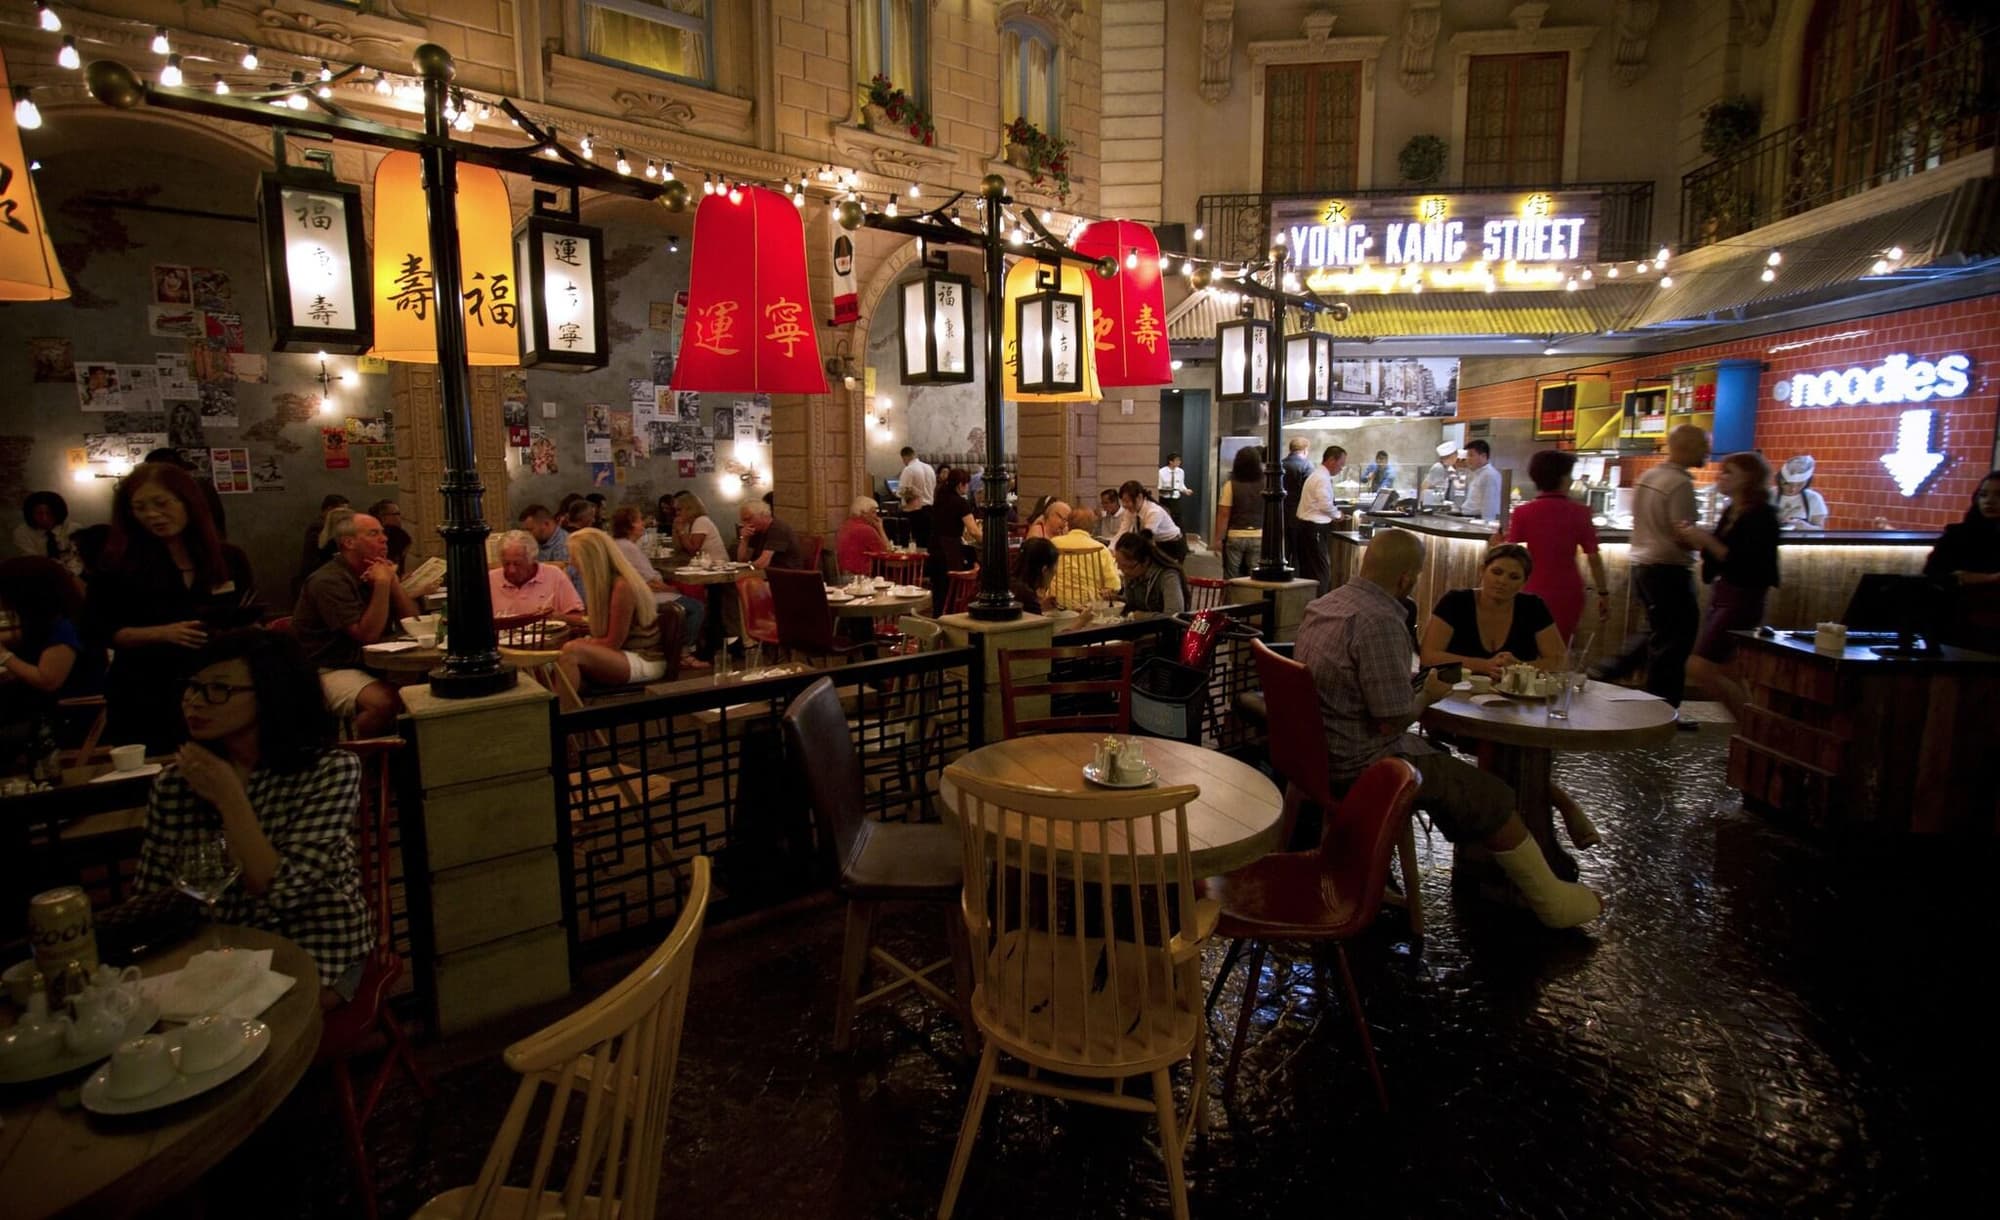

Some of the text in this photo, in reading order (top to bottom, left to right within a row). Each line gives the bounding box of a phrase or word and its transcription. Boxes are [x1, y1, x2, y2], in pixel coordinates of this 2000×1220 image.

[1290, 218, 1585, 266] YONG KANG STREET
[462, 272, 517, 328] 福
[694, 296, 810, 359] 運 寧
[1131, 303, 1163, 355] 壽
[1790, 353, 1970, 408] noodles
